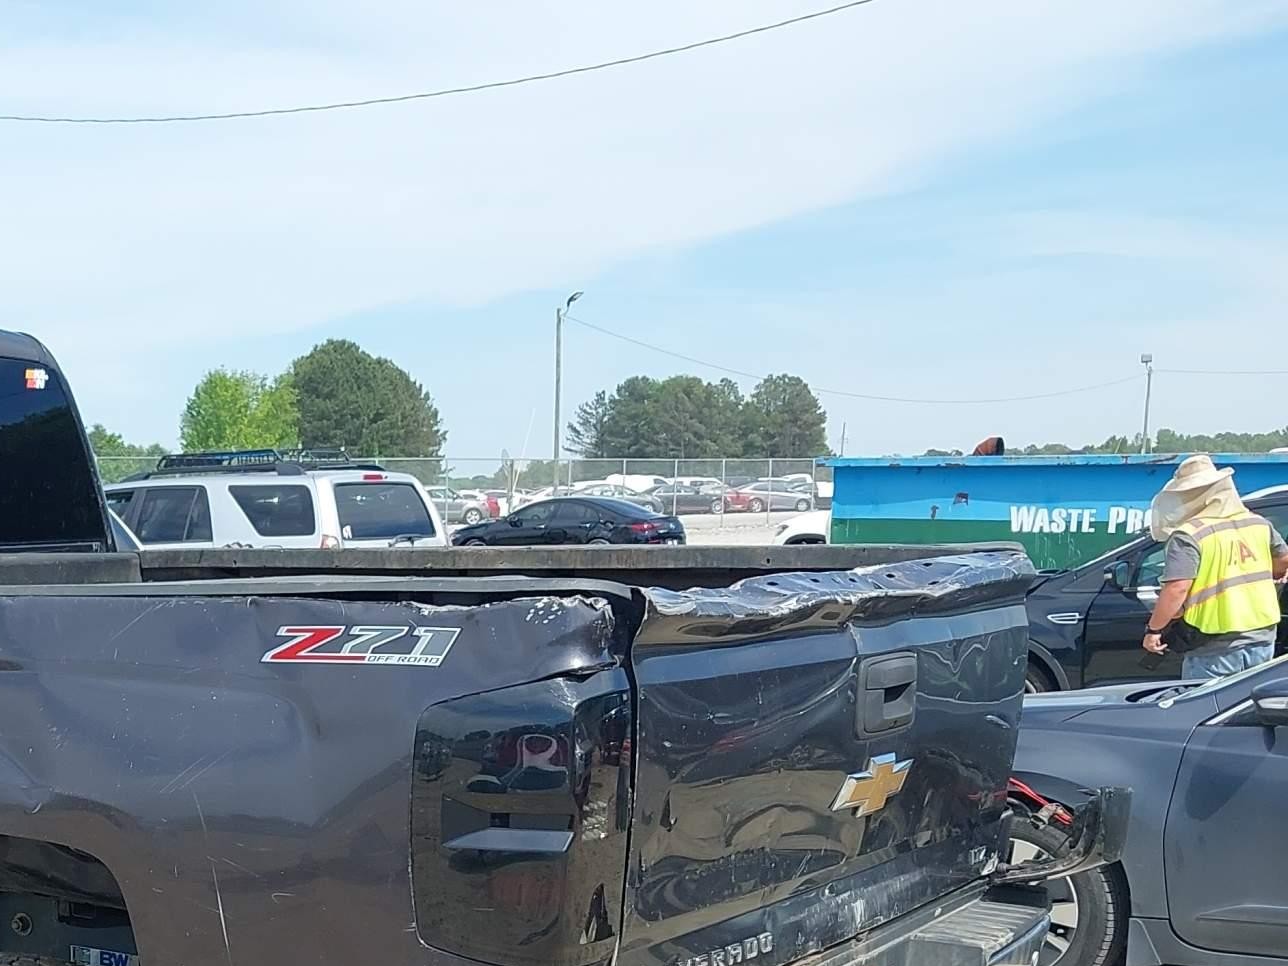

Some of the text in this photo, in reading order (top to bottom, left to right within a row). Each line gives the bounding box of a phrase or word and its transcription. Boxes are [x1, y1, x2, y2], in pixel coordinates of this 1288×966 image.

[1010, 505, 1096, 533] WASTE
[261, 625, 462, 663] Z71
[367, 655, 441, 664] OFF ROAD
